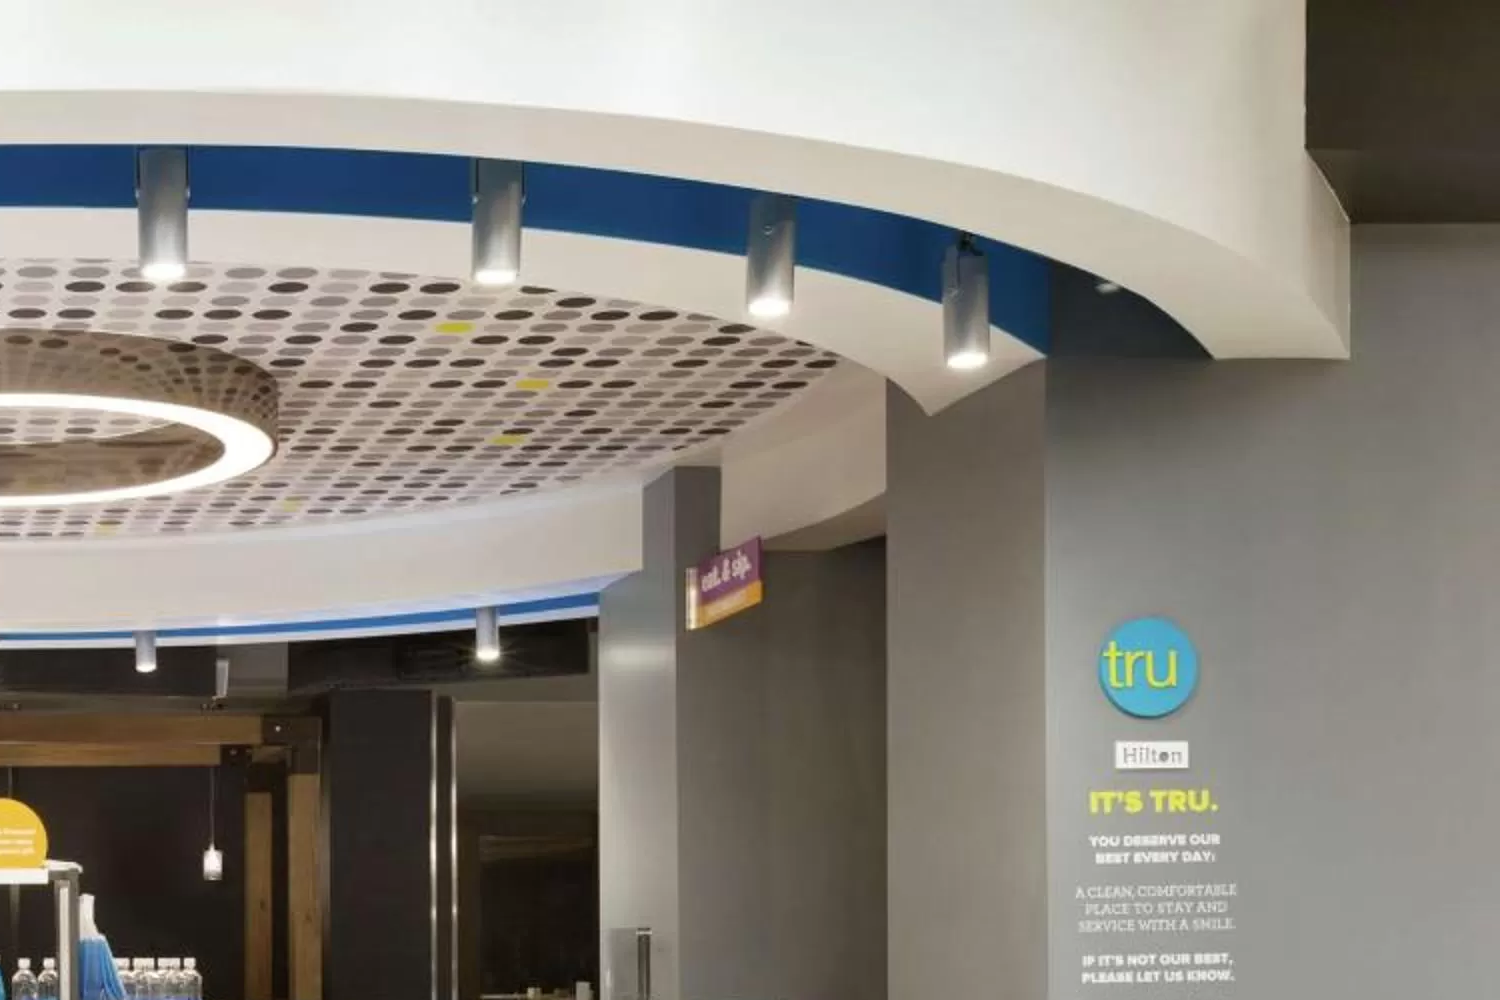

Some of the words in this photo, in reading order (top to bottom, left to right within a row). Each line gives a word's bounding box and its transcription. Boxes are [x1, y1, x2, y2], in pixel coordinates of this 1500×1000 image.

[1103, 640, 1178, 688] tru
[1122, 746, 1182, 765] Hilton
[1089, 790, 1143, 814] IT'S
[1149, 789, 1219, 812] TRU.
[1088, 835, 1120, 847] YOU
[1123, 834, 1187, 847] DESERVE
[1189, 833, 1221, 845] OUR
[1095, 853, 1129, 864] BEST
[1133, 852, 1178, 864] EVERY
[1076, 888, 1085, 899] A
[1137, 883, 1237, 898] COMFORTABLE
[1085, 903, 1130, 915] PLACE
[1135, 902, 1153, 914] TO
[1157, 901, 1193, 914] STAY
[1196, 901, 1229, 913] AND
[1078, 920, 1135, 933] SERVICE
[1138, 919, 1175, 932] WITH
[1179, 919, 1189, 931] A
[1082, 955, 1095, 967] IF
[1098, 955, 1124, 967] IT'S
[1127, 954, 1157, 966] NOT
[1159, 953, 1190, 965] OUR
[1081, 971, 1133, 984] PLEASE
[1137, 970, 1161, 983] LET
[1164, 970, 1184, 982] US
[1187, 969, 1235, 981] KNOW.
